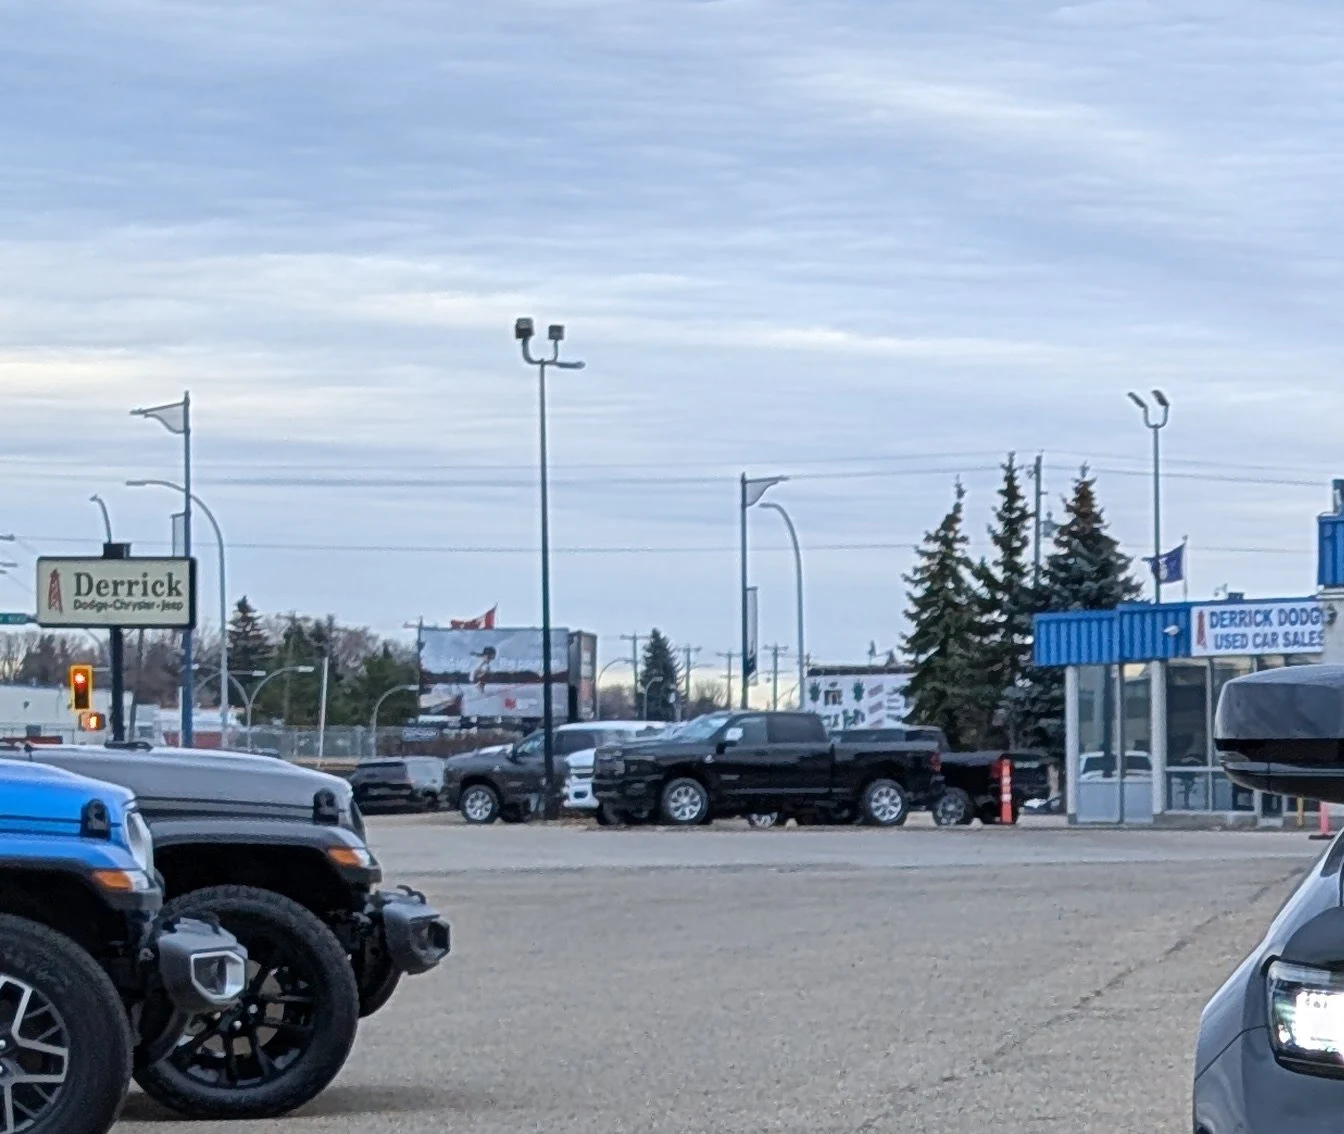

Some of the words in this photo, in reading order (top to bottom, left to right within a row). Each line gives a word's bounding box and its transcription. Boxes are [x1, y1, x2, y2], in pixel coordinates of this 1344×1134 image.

[74, 572, 183, 597] Derrick
[1209, 608, 1273, 629] DERRICK
[1278, 606, 1324, 627] DODG
[1214, 633, 1249, 650] USED
[1252, 631, 1279, 649] CAR
